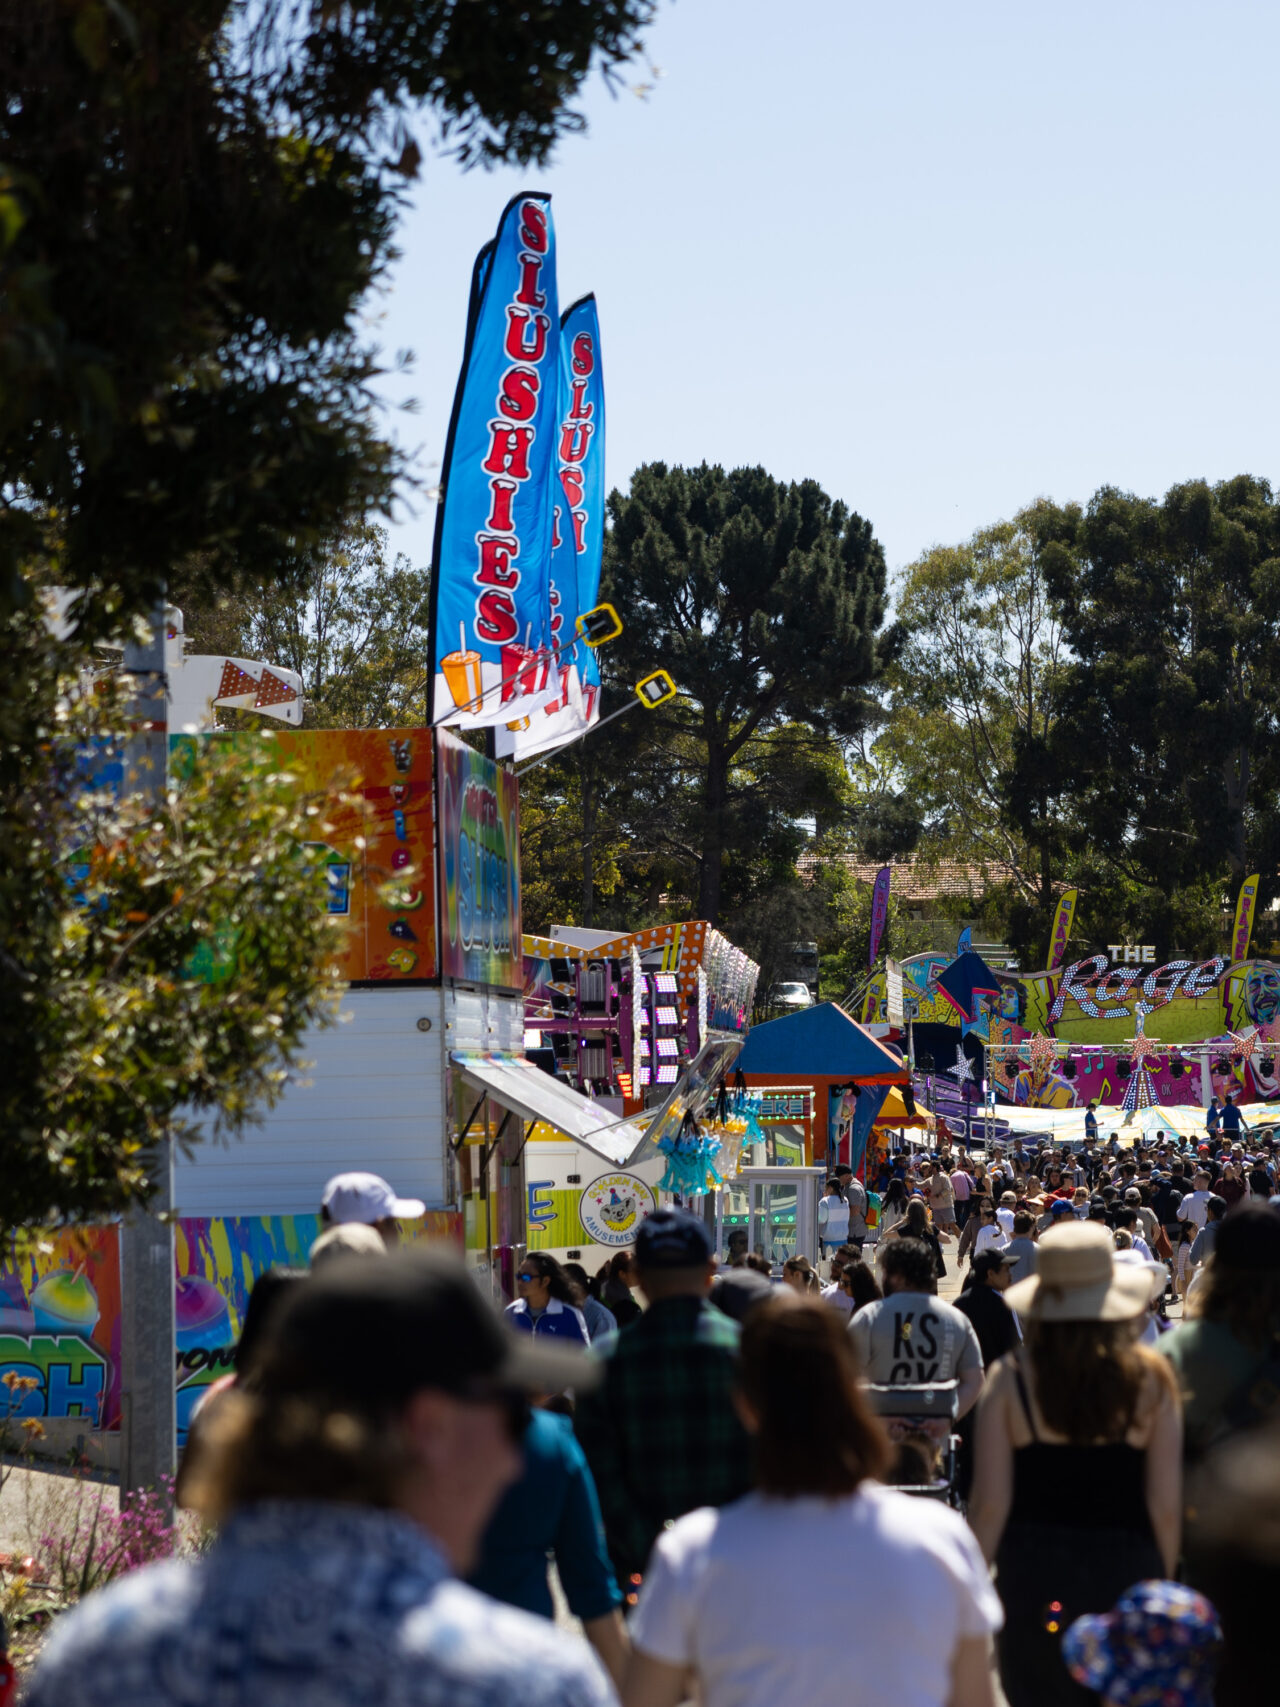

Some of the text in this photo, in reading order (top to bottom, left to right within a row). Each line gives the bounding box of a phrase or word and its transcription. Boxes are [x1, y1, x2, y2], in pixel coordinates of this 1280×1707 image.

[475, 199, 549, 645] SLUSHIES
[458, 830, 510, 953] SLUSH
[1235, 897, 1251, 960] RAGE
[1107, 945, 1156, 963] THE
